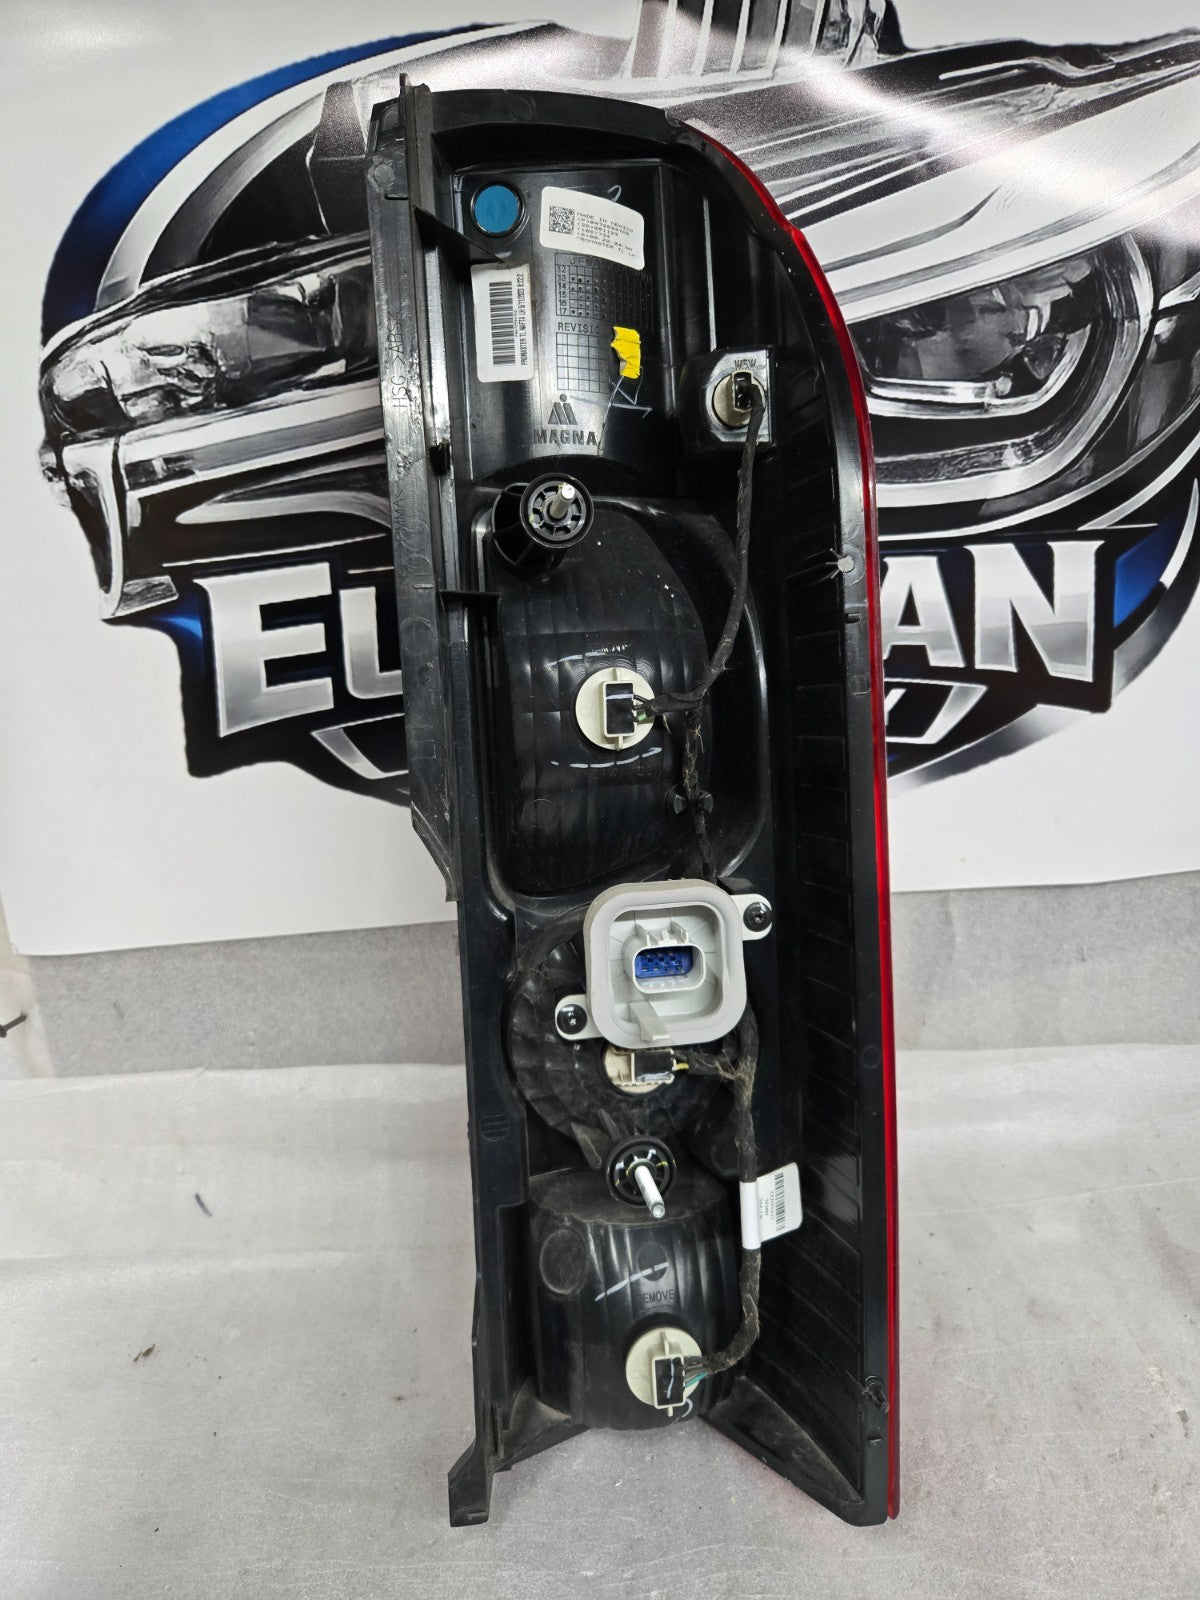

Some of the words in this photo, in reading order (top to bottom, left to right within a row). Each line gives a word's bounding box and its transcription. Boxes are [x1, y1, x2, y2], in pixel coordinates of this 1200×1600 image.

[577, 212, 595, 220] MADE
[610, 220, 634, 233] MEXICO
[558, 291, 567, 299] 15
[558, 299, 567, 307] 16
[558, 307, 568, 315] 17
[519, 338, 528, 366] PROMASTER
[533, 428, 598, 446] MAGNA
[638, 1288, 675, 1304] EMOVE
